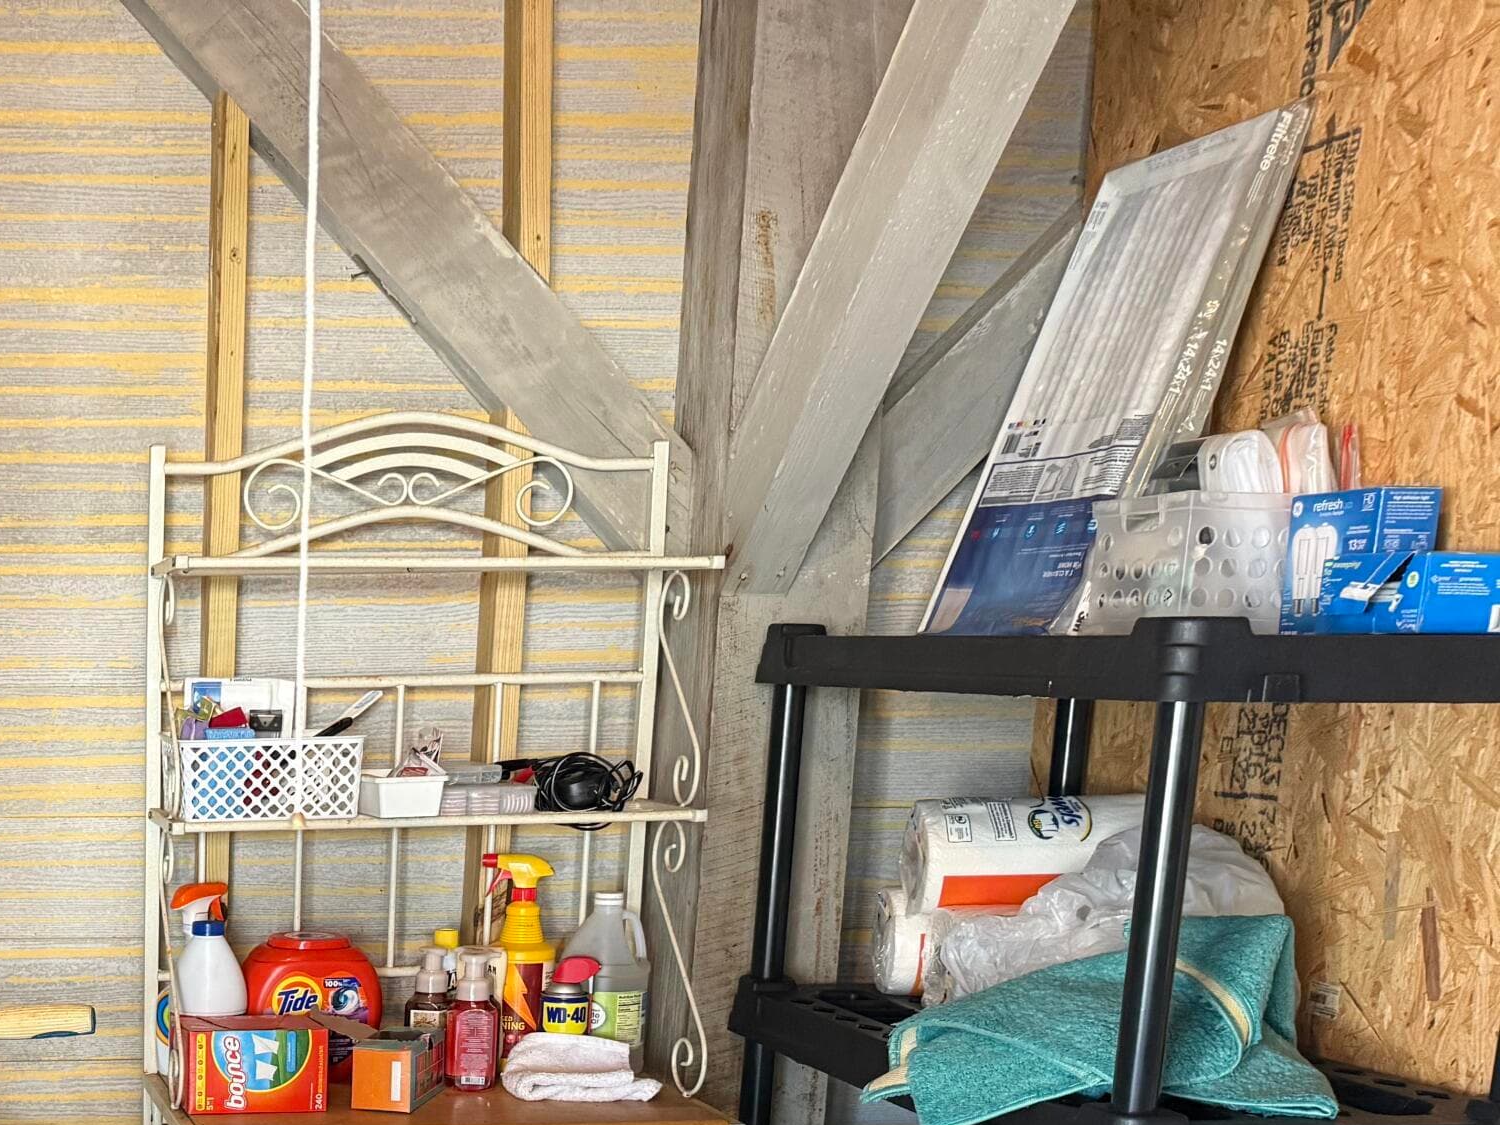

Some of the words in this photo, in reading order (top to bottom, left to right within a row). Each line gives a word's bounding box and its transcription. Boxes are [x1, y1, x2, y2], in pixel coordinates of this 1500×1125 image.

[1259, 110, 1294, 171] Filtrete
[1167, 342, 1199, 394] 14x24x1
[1200, 338, 1228, 392] 14x24x1
[1312, 498, 1344, 513] refresh
[277, 986, 318, 1016] Tide
[546, 1005, 587, 1024] WD-40
[223, 1035, 248, 1111] bounce
[315, 1093, 323, 1110] 240
